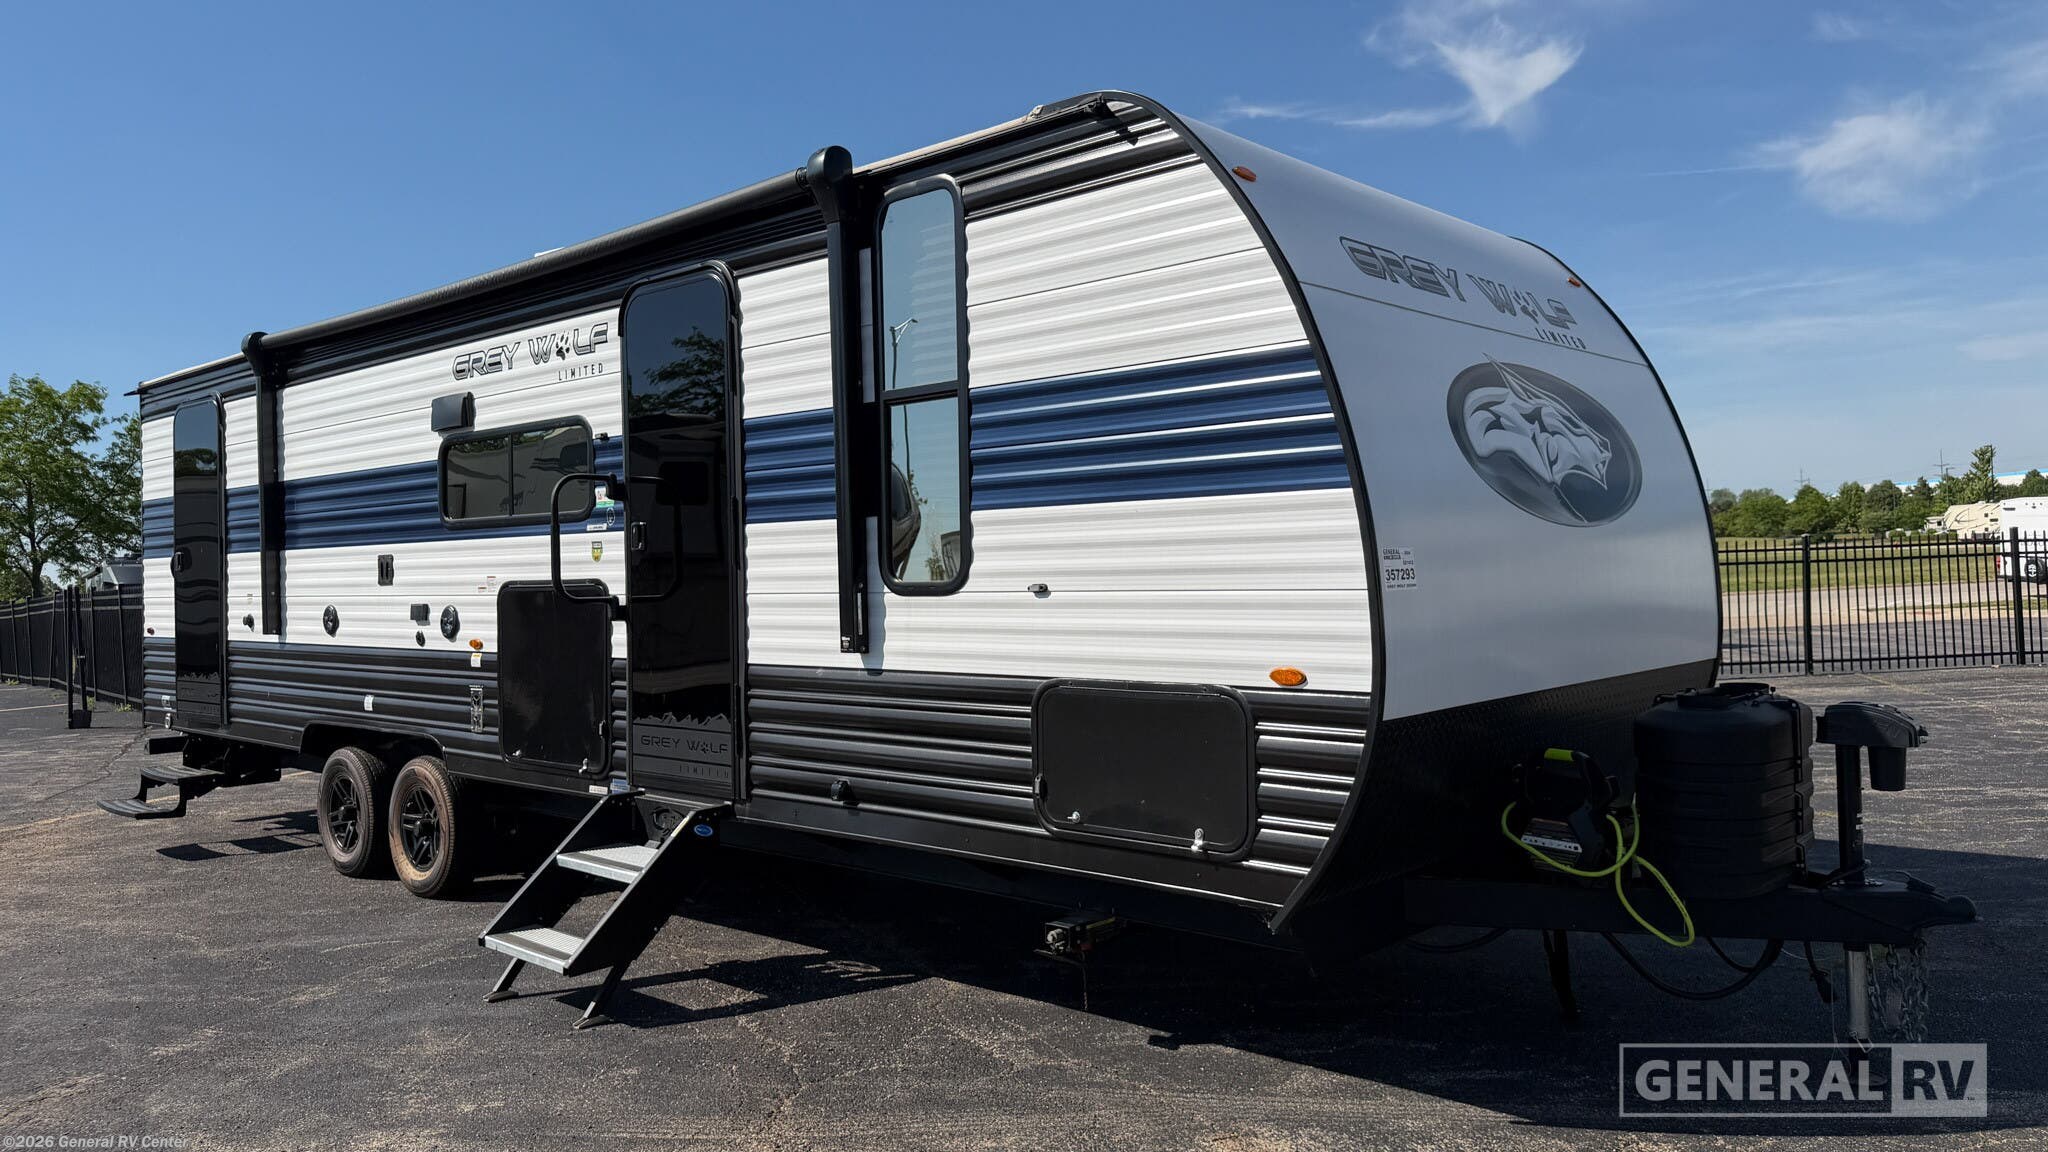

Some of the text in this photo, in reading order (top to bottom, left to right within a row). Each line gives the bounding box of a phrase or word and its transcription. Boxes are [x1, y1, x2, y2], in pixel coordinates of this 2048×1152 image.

[1340, 236, 1467, 302] GREY
[1535, 327, 1586, 349] LIMITED
[453, 342, 520, 380] GREY
[558, 362, 604, 381] LIMITED
[1385, 568, 1415, 581] 357293
[641, 735, 681, 748] GREY
